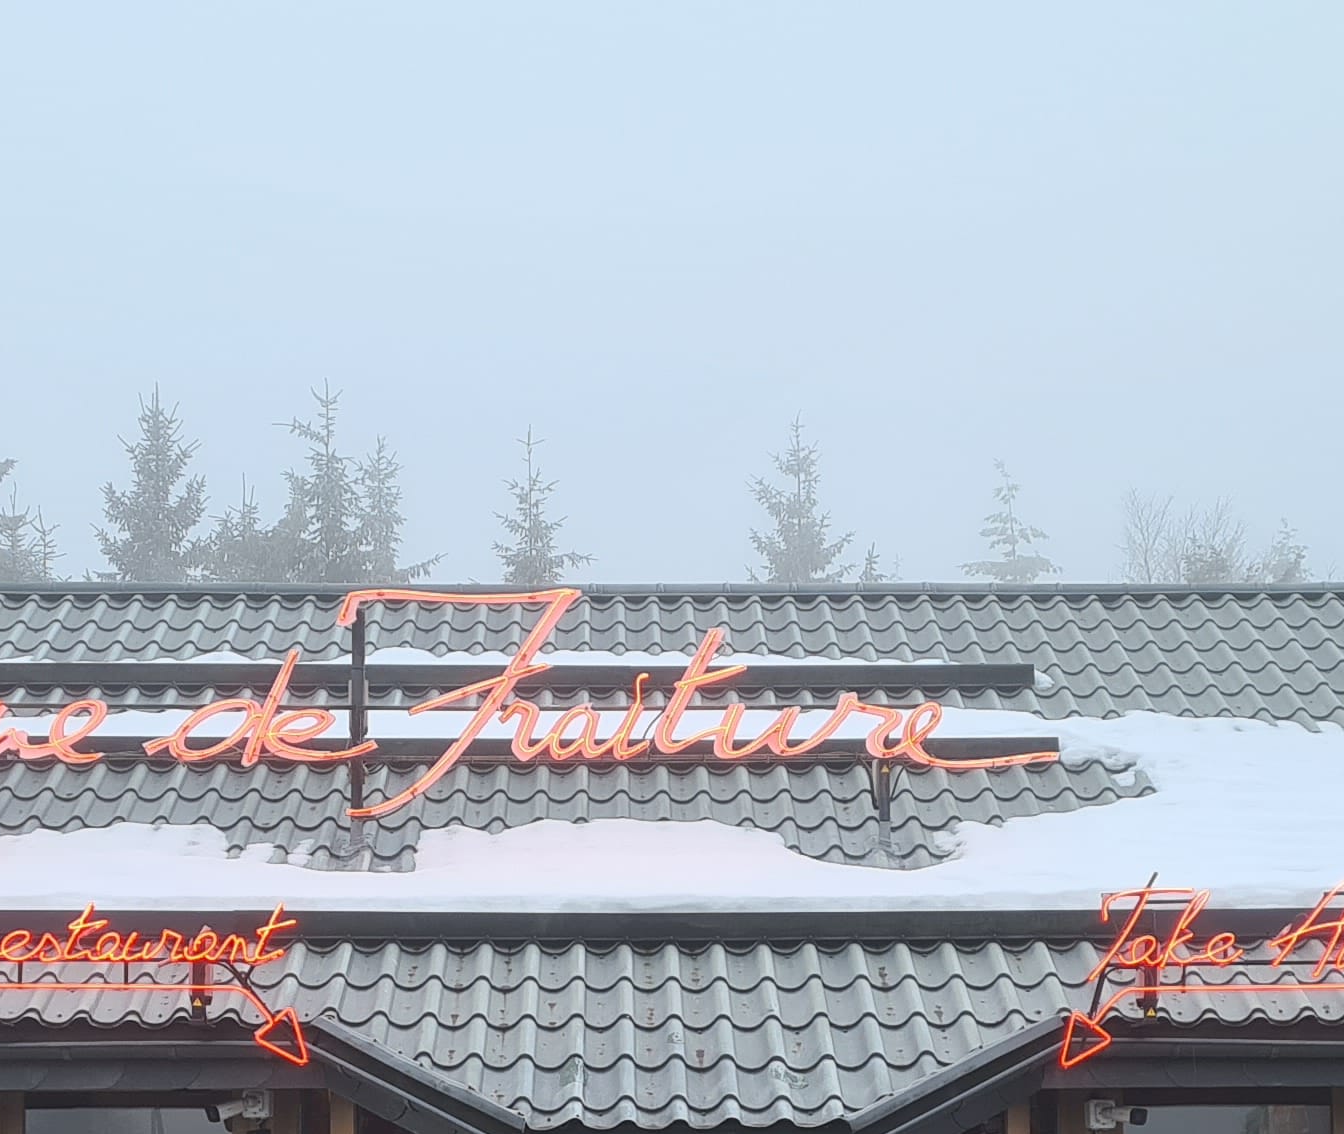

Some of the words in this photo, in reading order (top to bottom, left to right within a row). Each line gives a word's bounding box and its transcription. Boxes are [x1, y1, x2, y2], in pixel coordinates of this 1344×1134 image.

[136, 648, 377, 767] de
[338, 588, 1061, 817] Fraiture
[1088, 886, 1244, 982] Take
